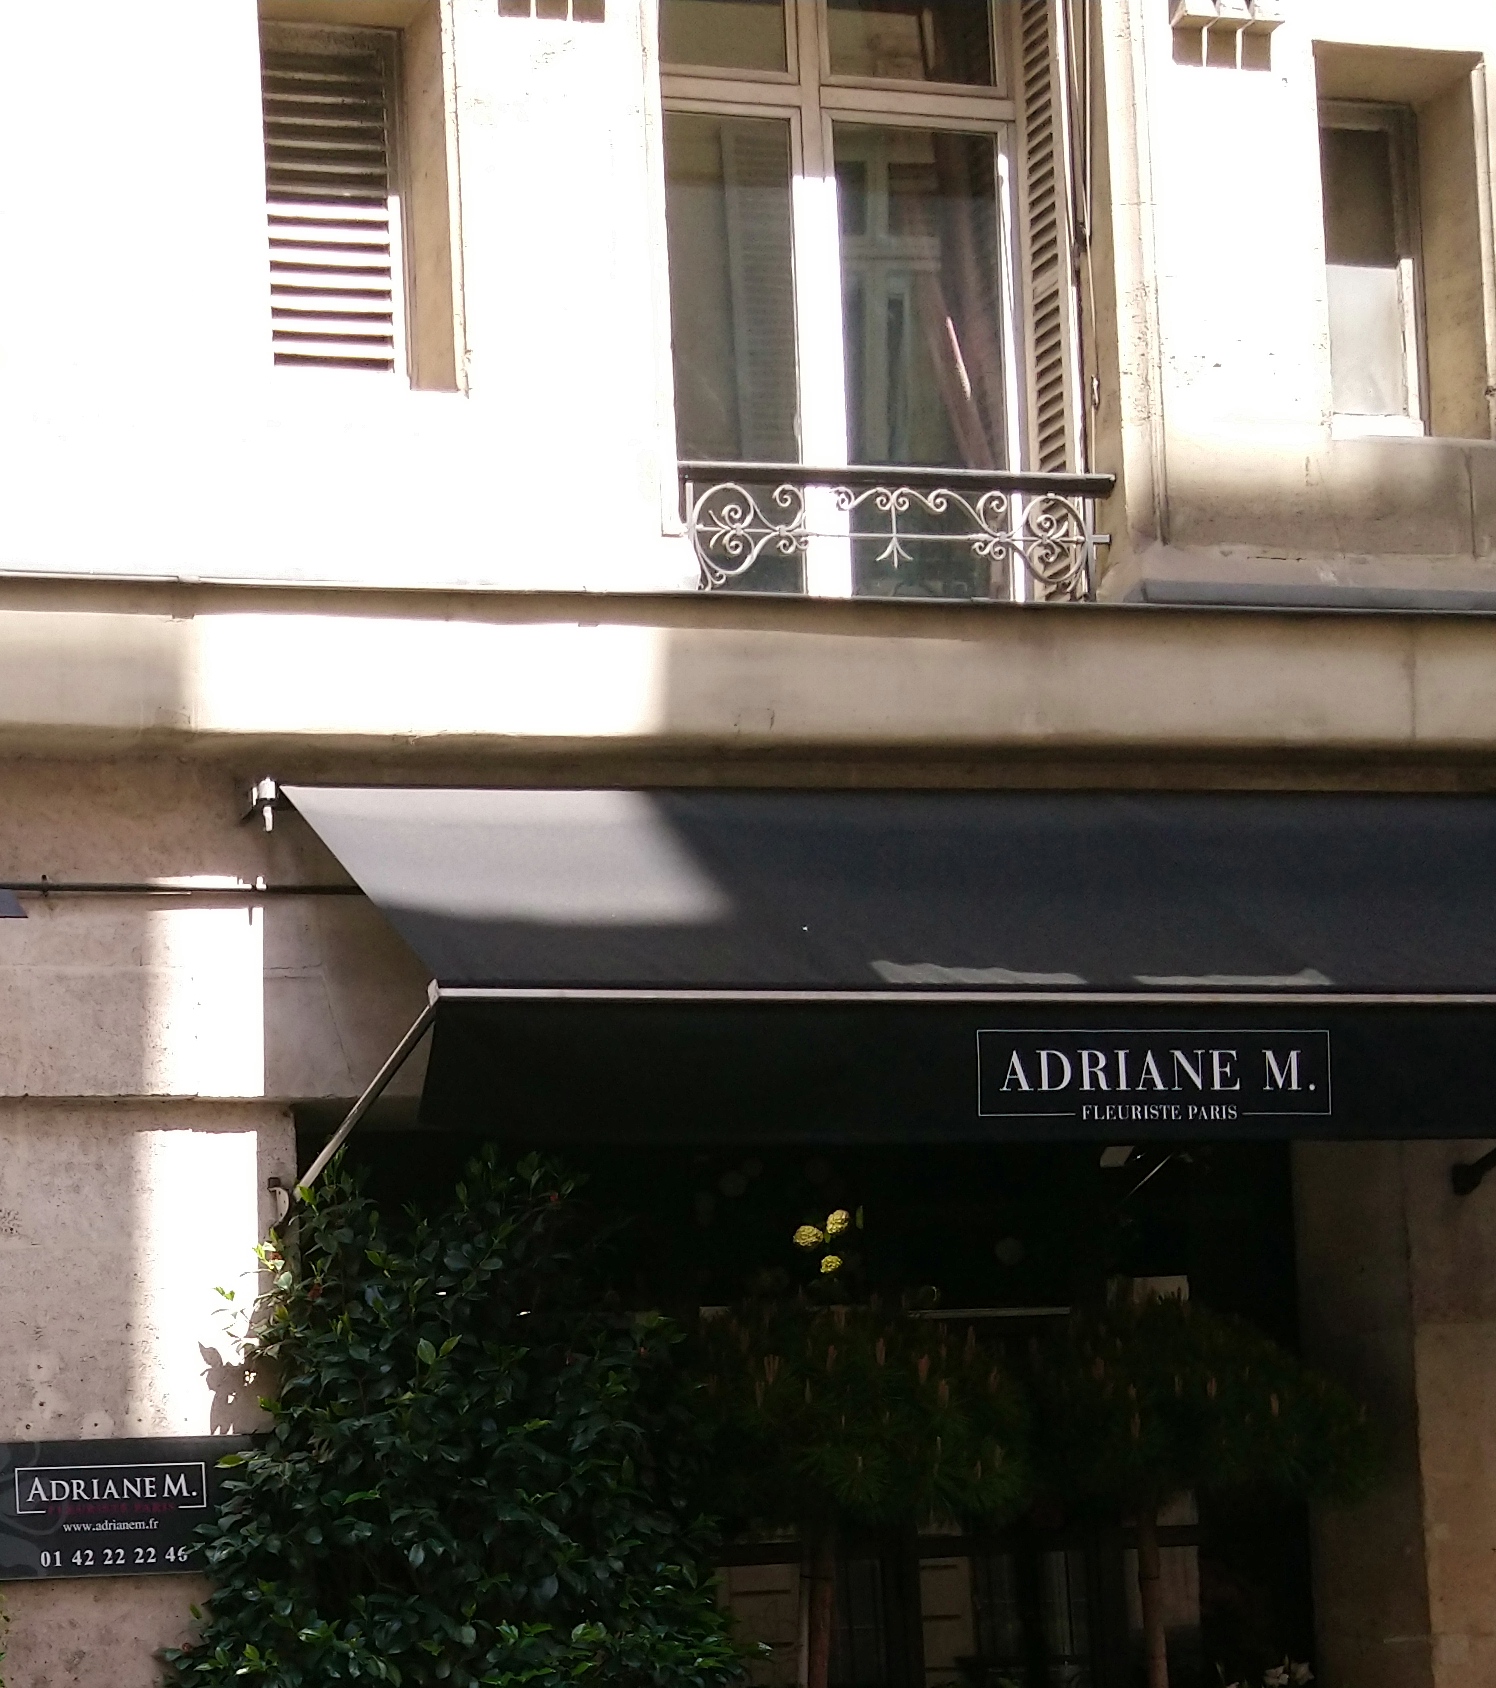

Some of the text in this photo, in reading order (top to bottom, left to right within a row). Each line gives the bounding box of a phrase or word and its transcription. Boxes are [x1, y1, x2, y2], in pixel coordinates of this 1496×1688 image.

[1000, 1050, 1315, 1091] ADRIANE M.
[1083, 1105, 1237, 1119] FLEURISTE PARIS
[163, 1474, 196, 1497] M.
[63, 1518, 158, 1531] www.adrianem.fr
[41, 1551, 61, 1567] 01
[72, 1550, 93, 1565] 42
[103, 1549, 125, 1564] 22
[134, 1548, 156, 1563] 22
